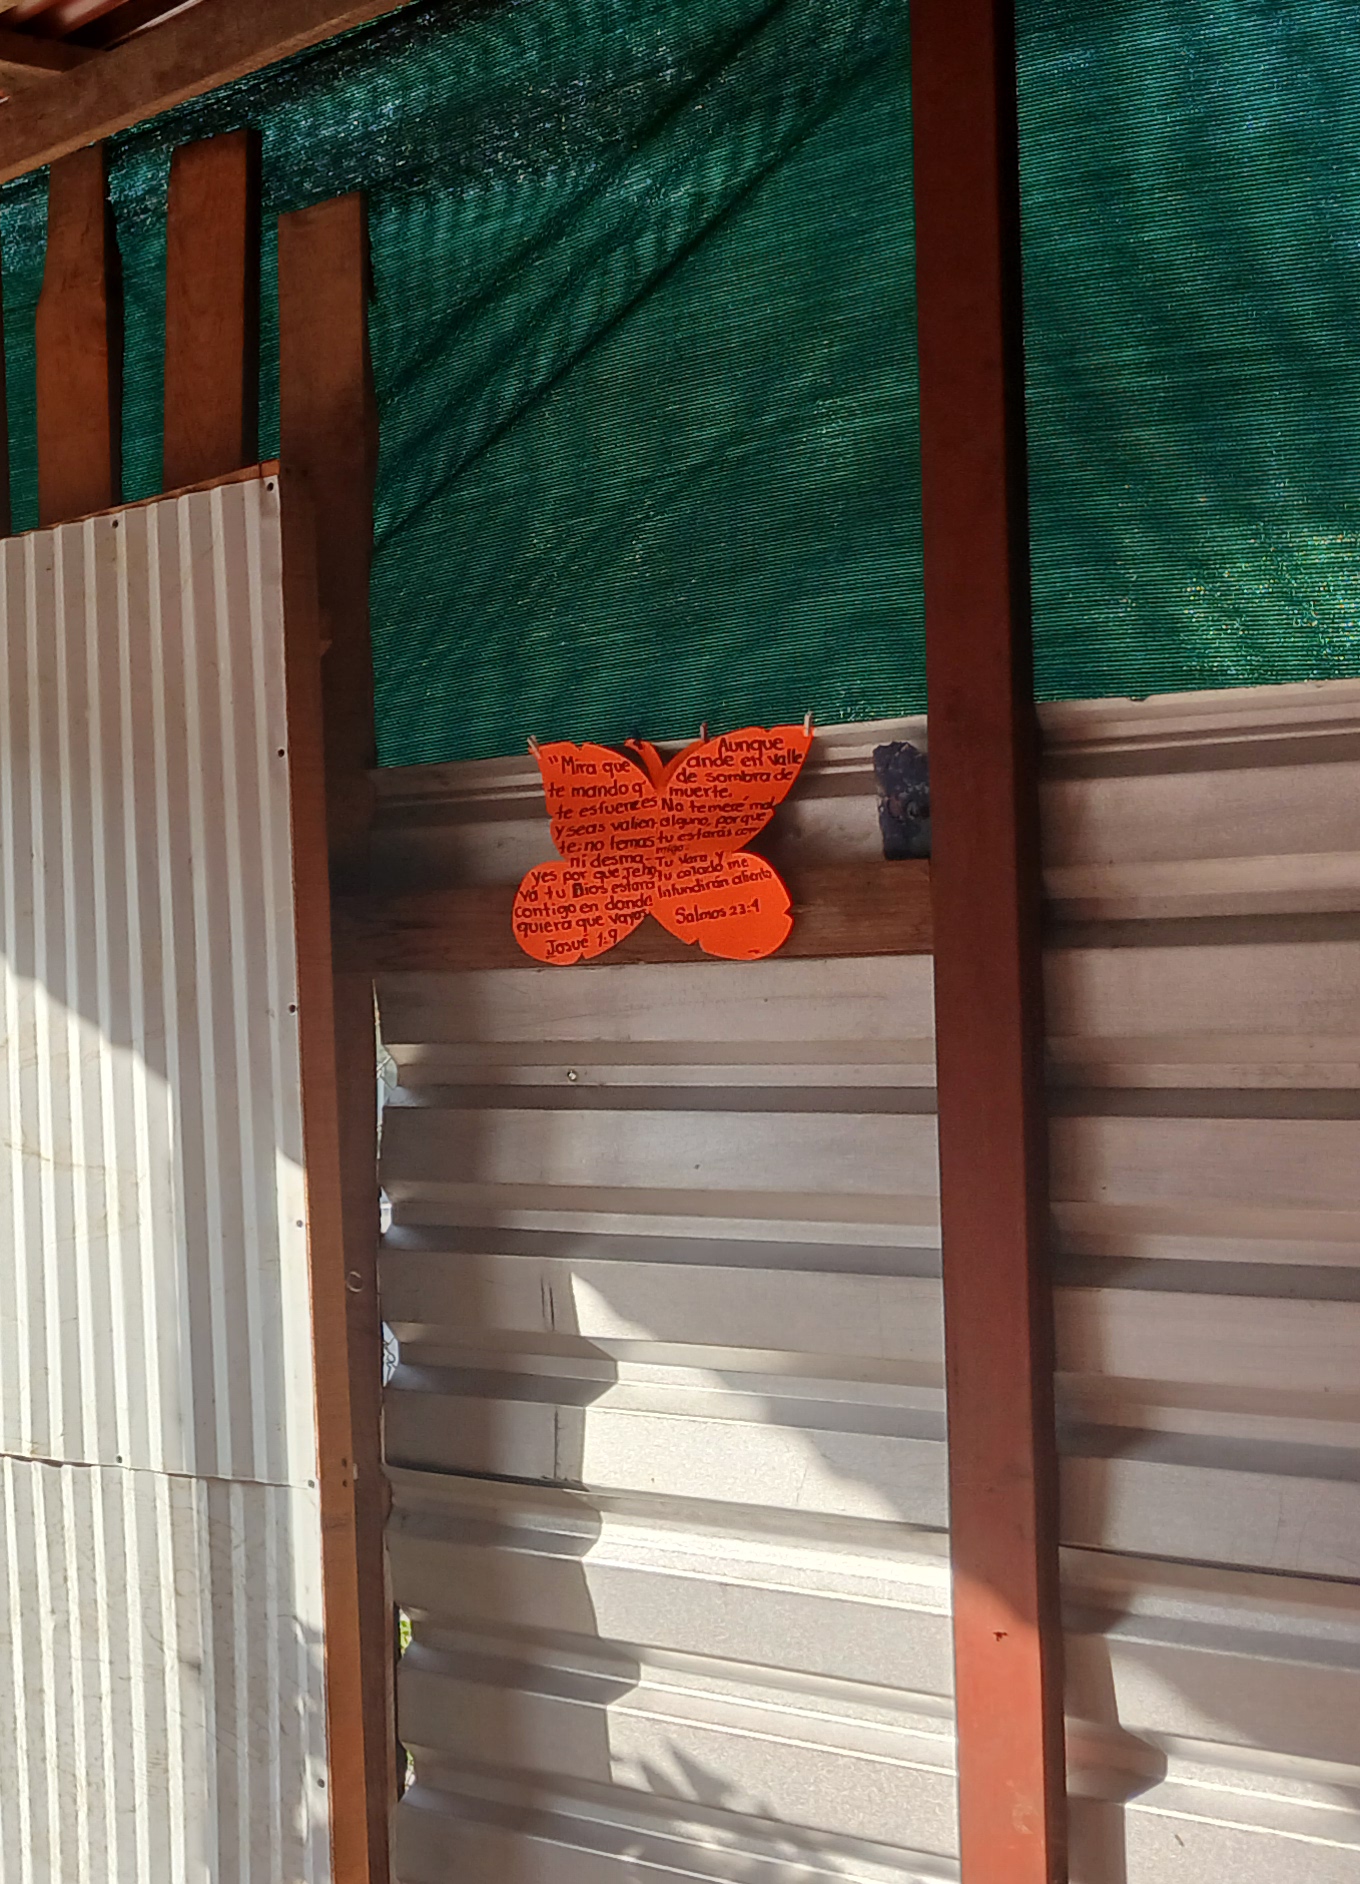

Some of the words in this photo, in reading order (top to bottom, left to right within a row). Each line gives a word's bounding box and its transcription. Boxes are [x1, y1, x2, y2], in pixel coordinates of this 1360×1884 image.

[718, 737, 784, 758] Aunque
[685, 755, 735, 768] ande
[767, 748, 803, 767] valle
[602, 760, 631, 779] que
[675, 766, 698, 785] de
[705, 770, 771, 783] sombra
[772, 767, 794, 782] de
[547, 781, 566, 798] te
[571, 779, 629, 798] mando
[555, 803, 573, 820] te
[661, 797, 684, 812] No
[570, 853, 587, 868] ni
[530, 871, 558, 889] yes
[562, 870, 588, 885] por
[544, 886, 567, 899] tu
[572, 881, 608, 899] Dios
[514, 902, 577, 919] contigo
[578, 902, 599, 913] en
[604, 893, 653, 911] donde
[674, 904, 727, 925] Salmos
[517, 919, 572, 938] quiera
[575, 915, 605, 934] que
[545, 934, 589, 955] Josué
